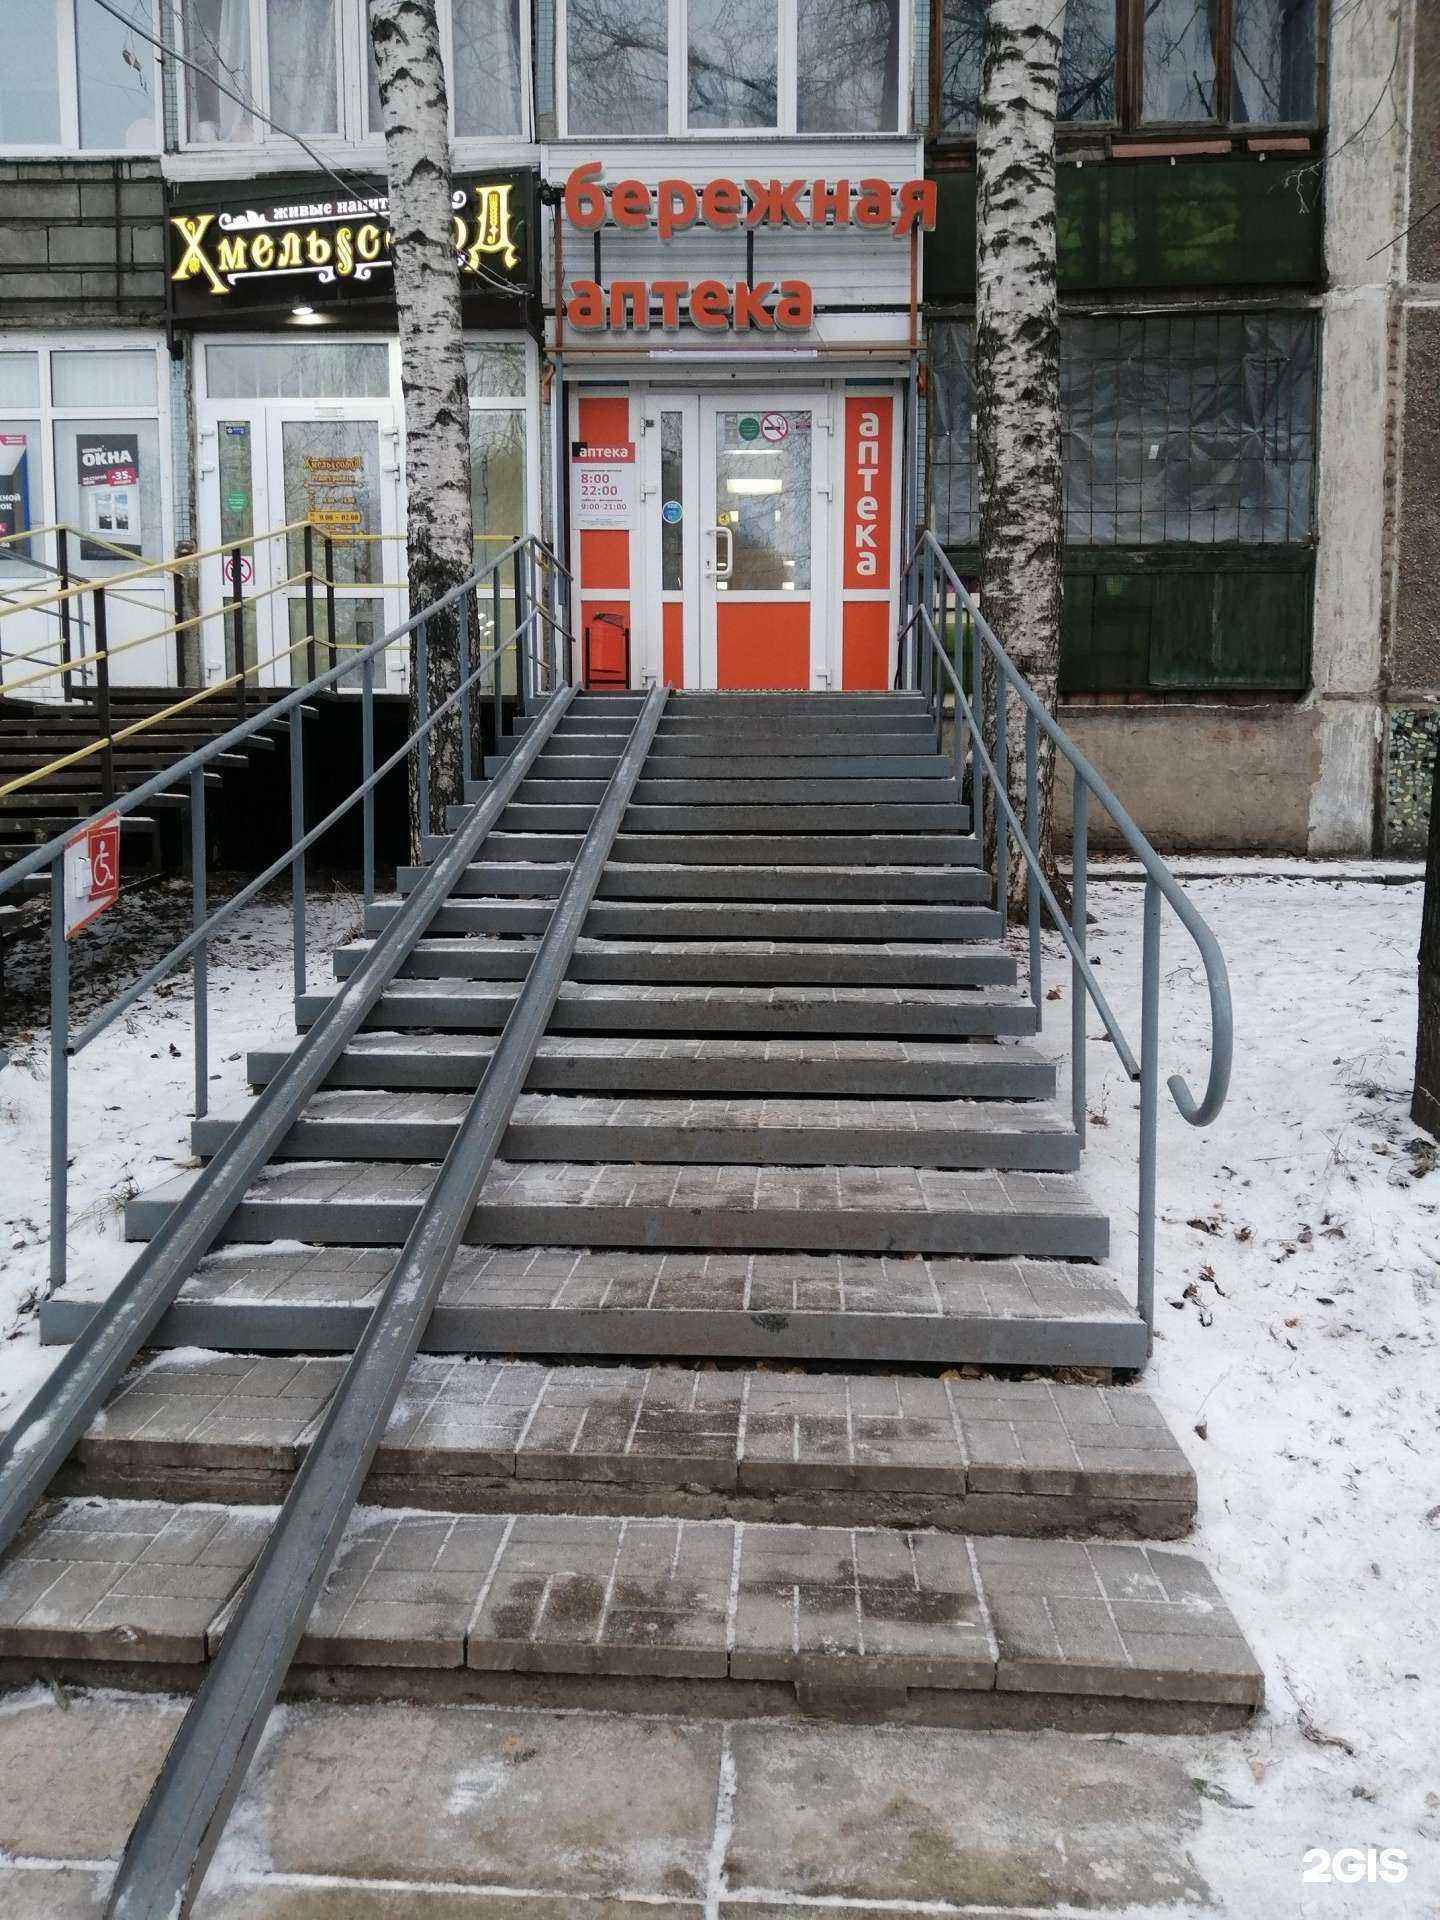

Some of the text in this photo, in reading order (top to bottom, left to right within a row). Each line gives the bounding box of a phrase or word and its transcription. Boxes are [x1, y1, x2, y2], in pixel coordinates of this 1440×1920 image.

[273, 197, 390, 220] живые напит
[564, 162, 937, 244] бережная
[566, 279, 814, 331] аптека
[82, 449, 133, 467] ОКНА
[579, 447, 629, 458] аптека
[580, 473, 610, 484] 8:00
[581, 485, 618, 496] 22:00
[855, 411, 879, 576] аптека
